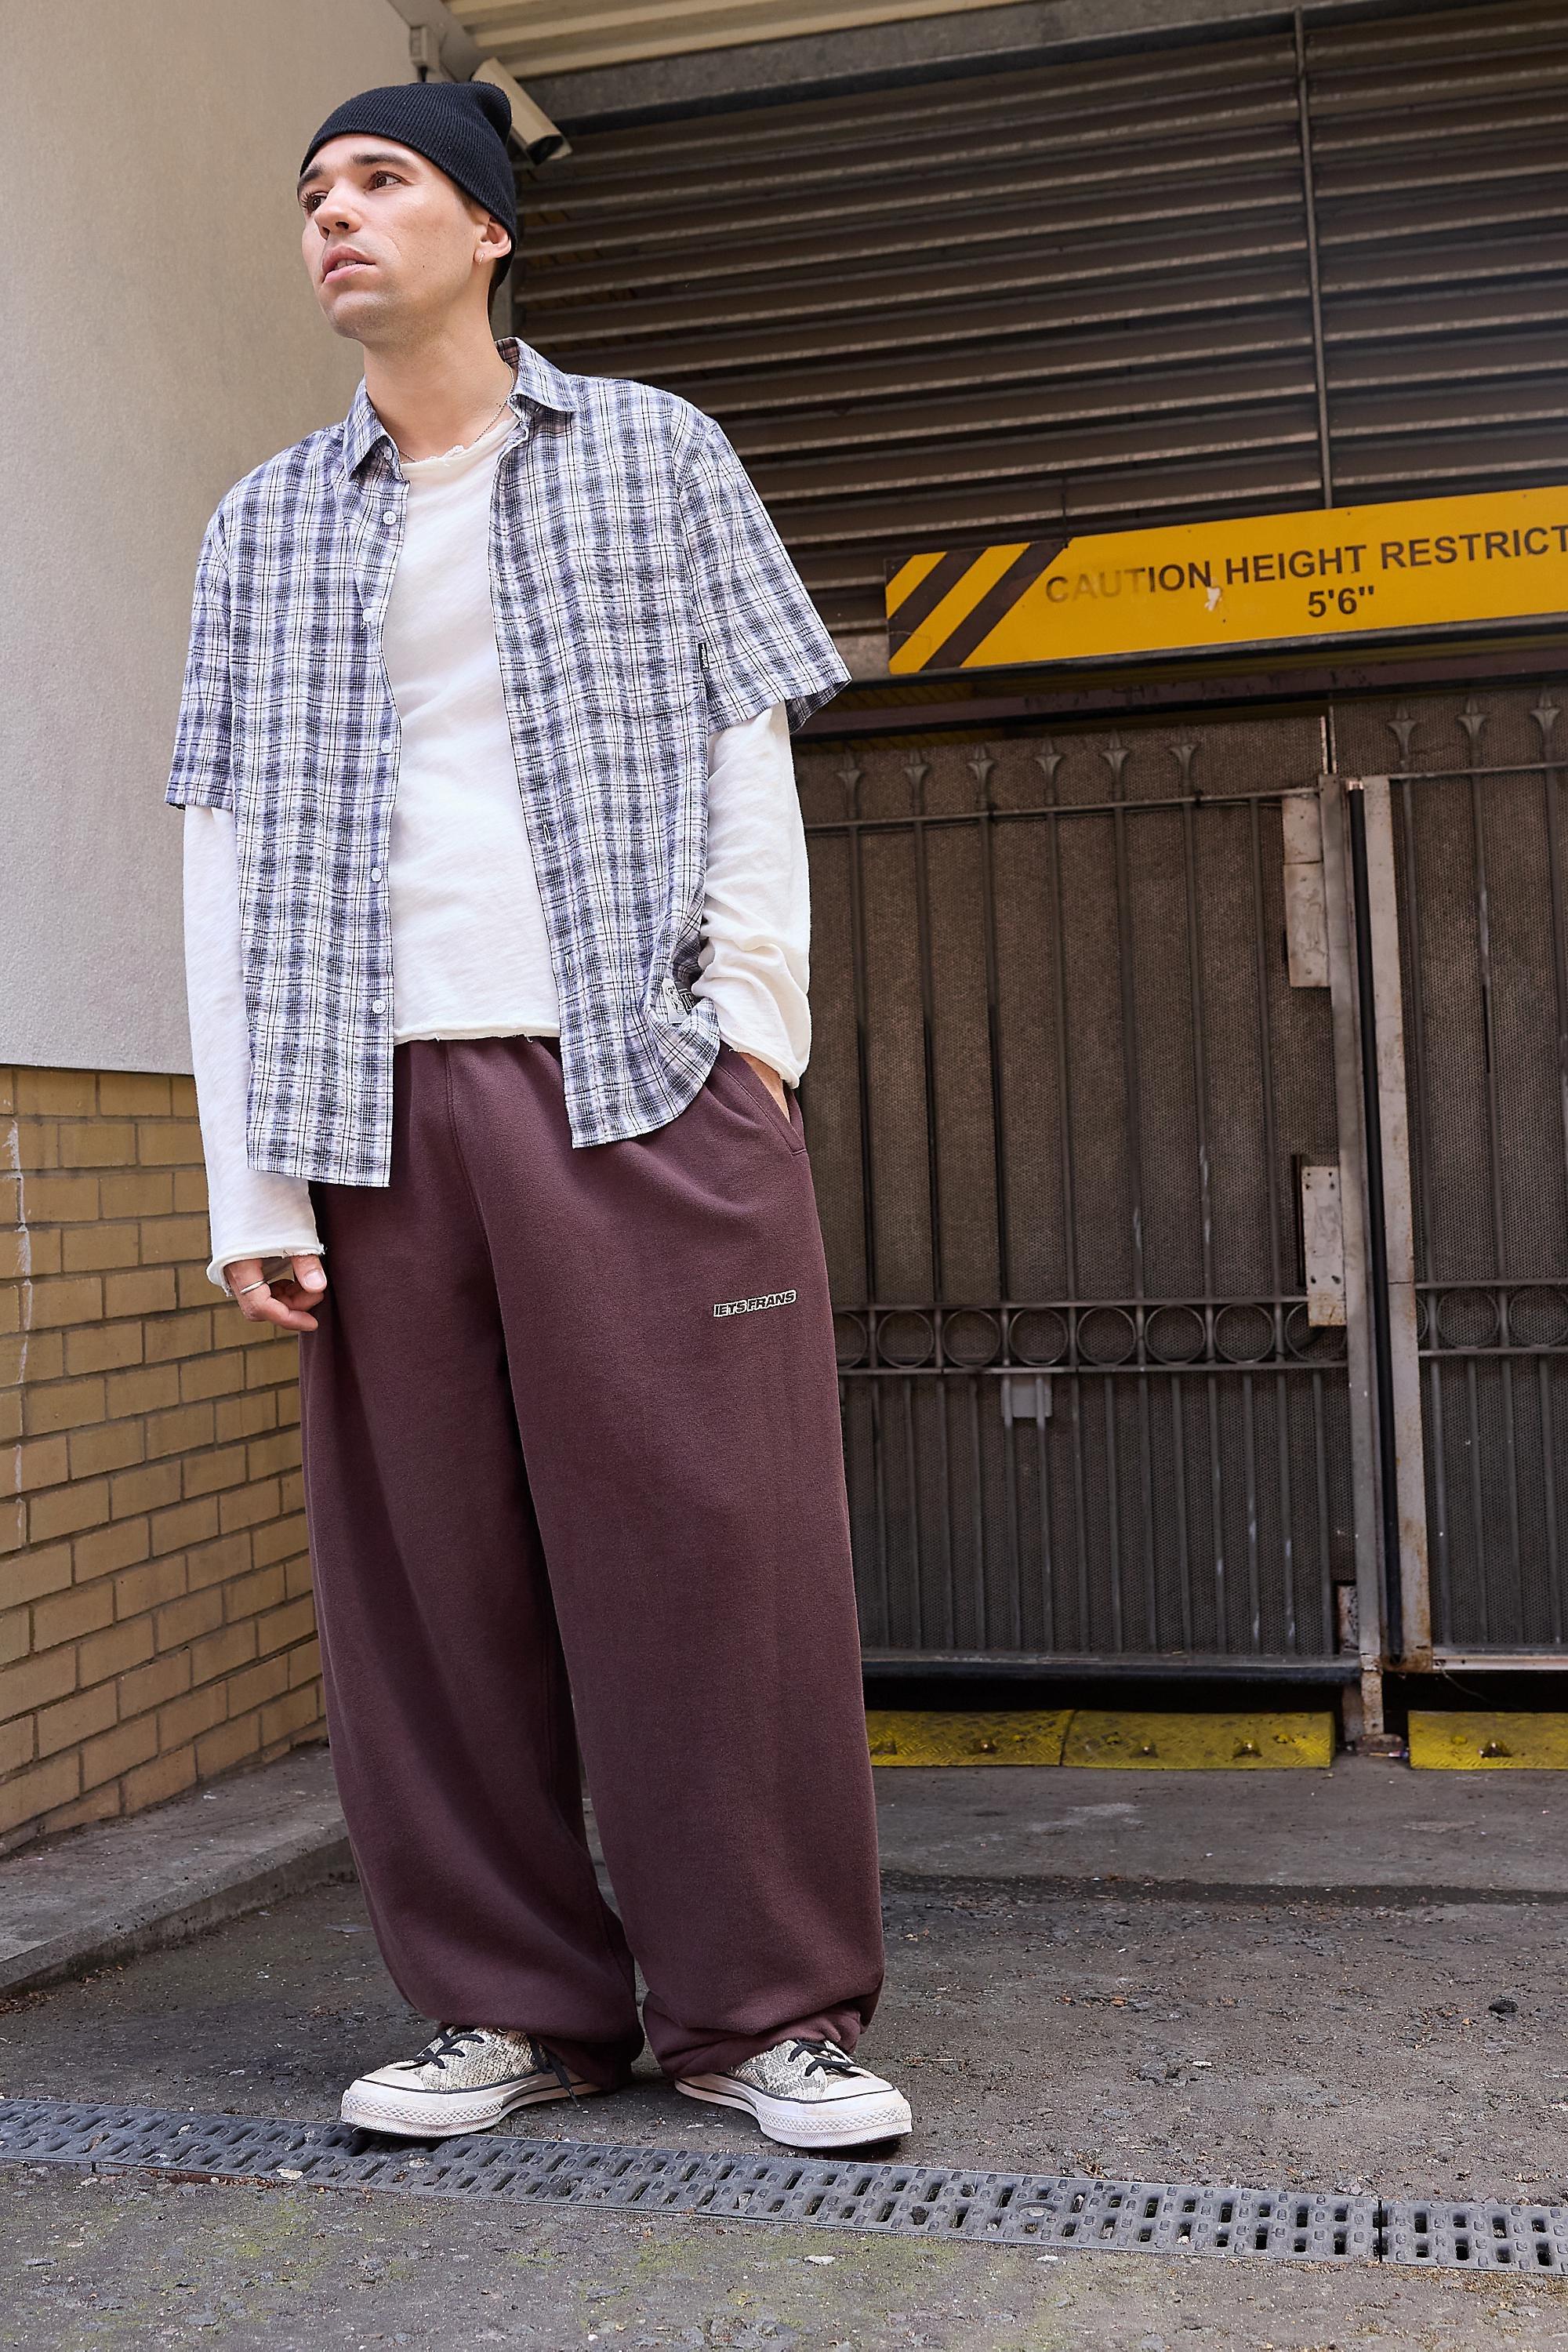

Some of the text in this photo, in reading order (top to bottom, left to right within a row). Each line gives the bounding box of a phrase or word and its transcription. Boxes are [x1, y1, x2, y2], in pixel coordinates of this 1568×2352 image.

[1046, 524, 1568, 604] CAUTION HEIGHT RESTRICT
[1308, 585, 1375, 619] 5'6"
